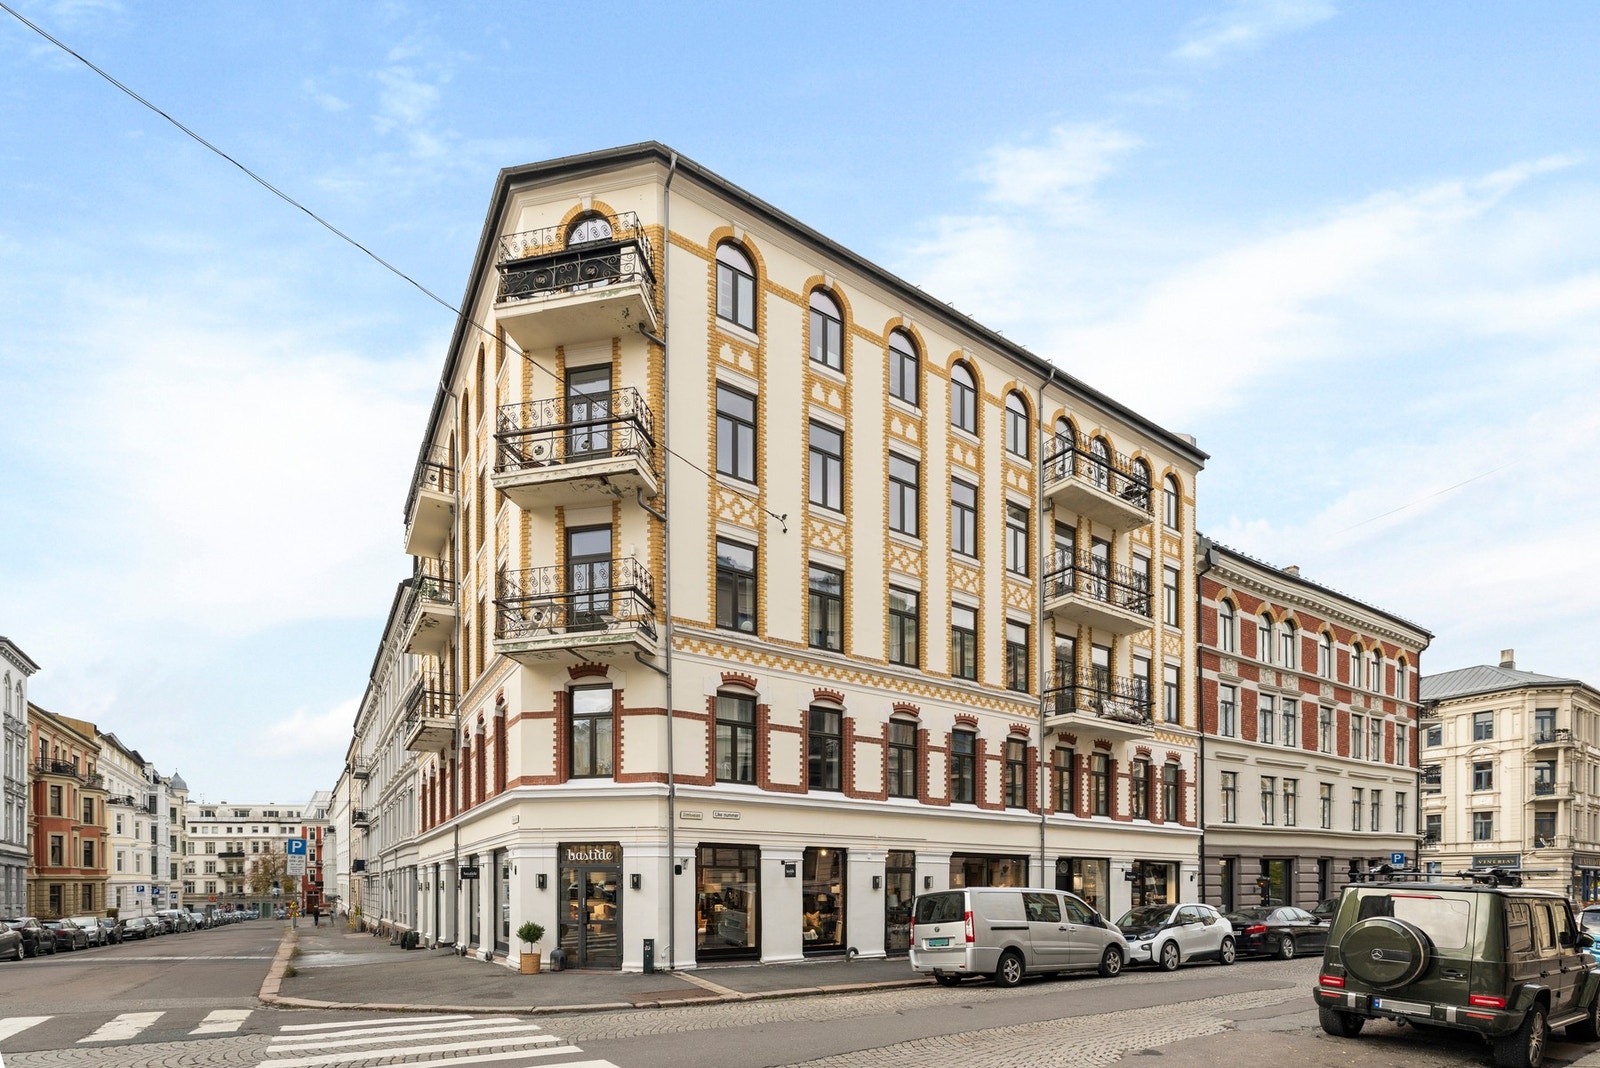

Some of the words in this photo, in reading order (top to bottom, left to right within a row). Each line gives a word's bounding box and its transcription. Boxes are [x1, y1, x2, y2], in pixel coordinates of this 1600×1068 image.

[291, 840, 303, 853] P
[566, 848, 614, 861] bastide
[1394, 854, 1402, 863] P
